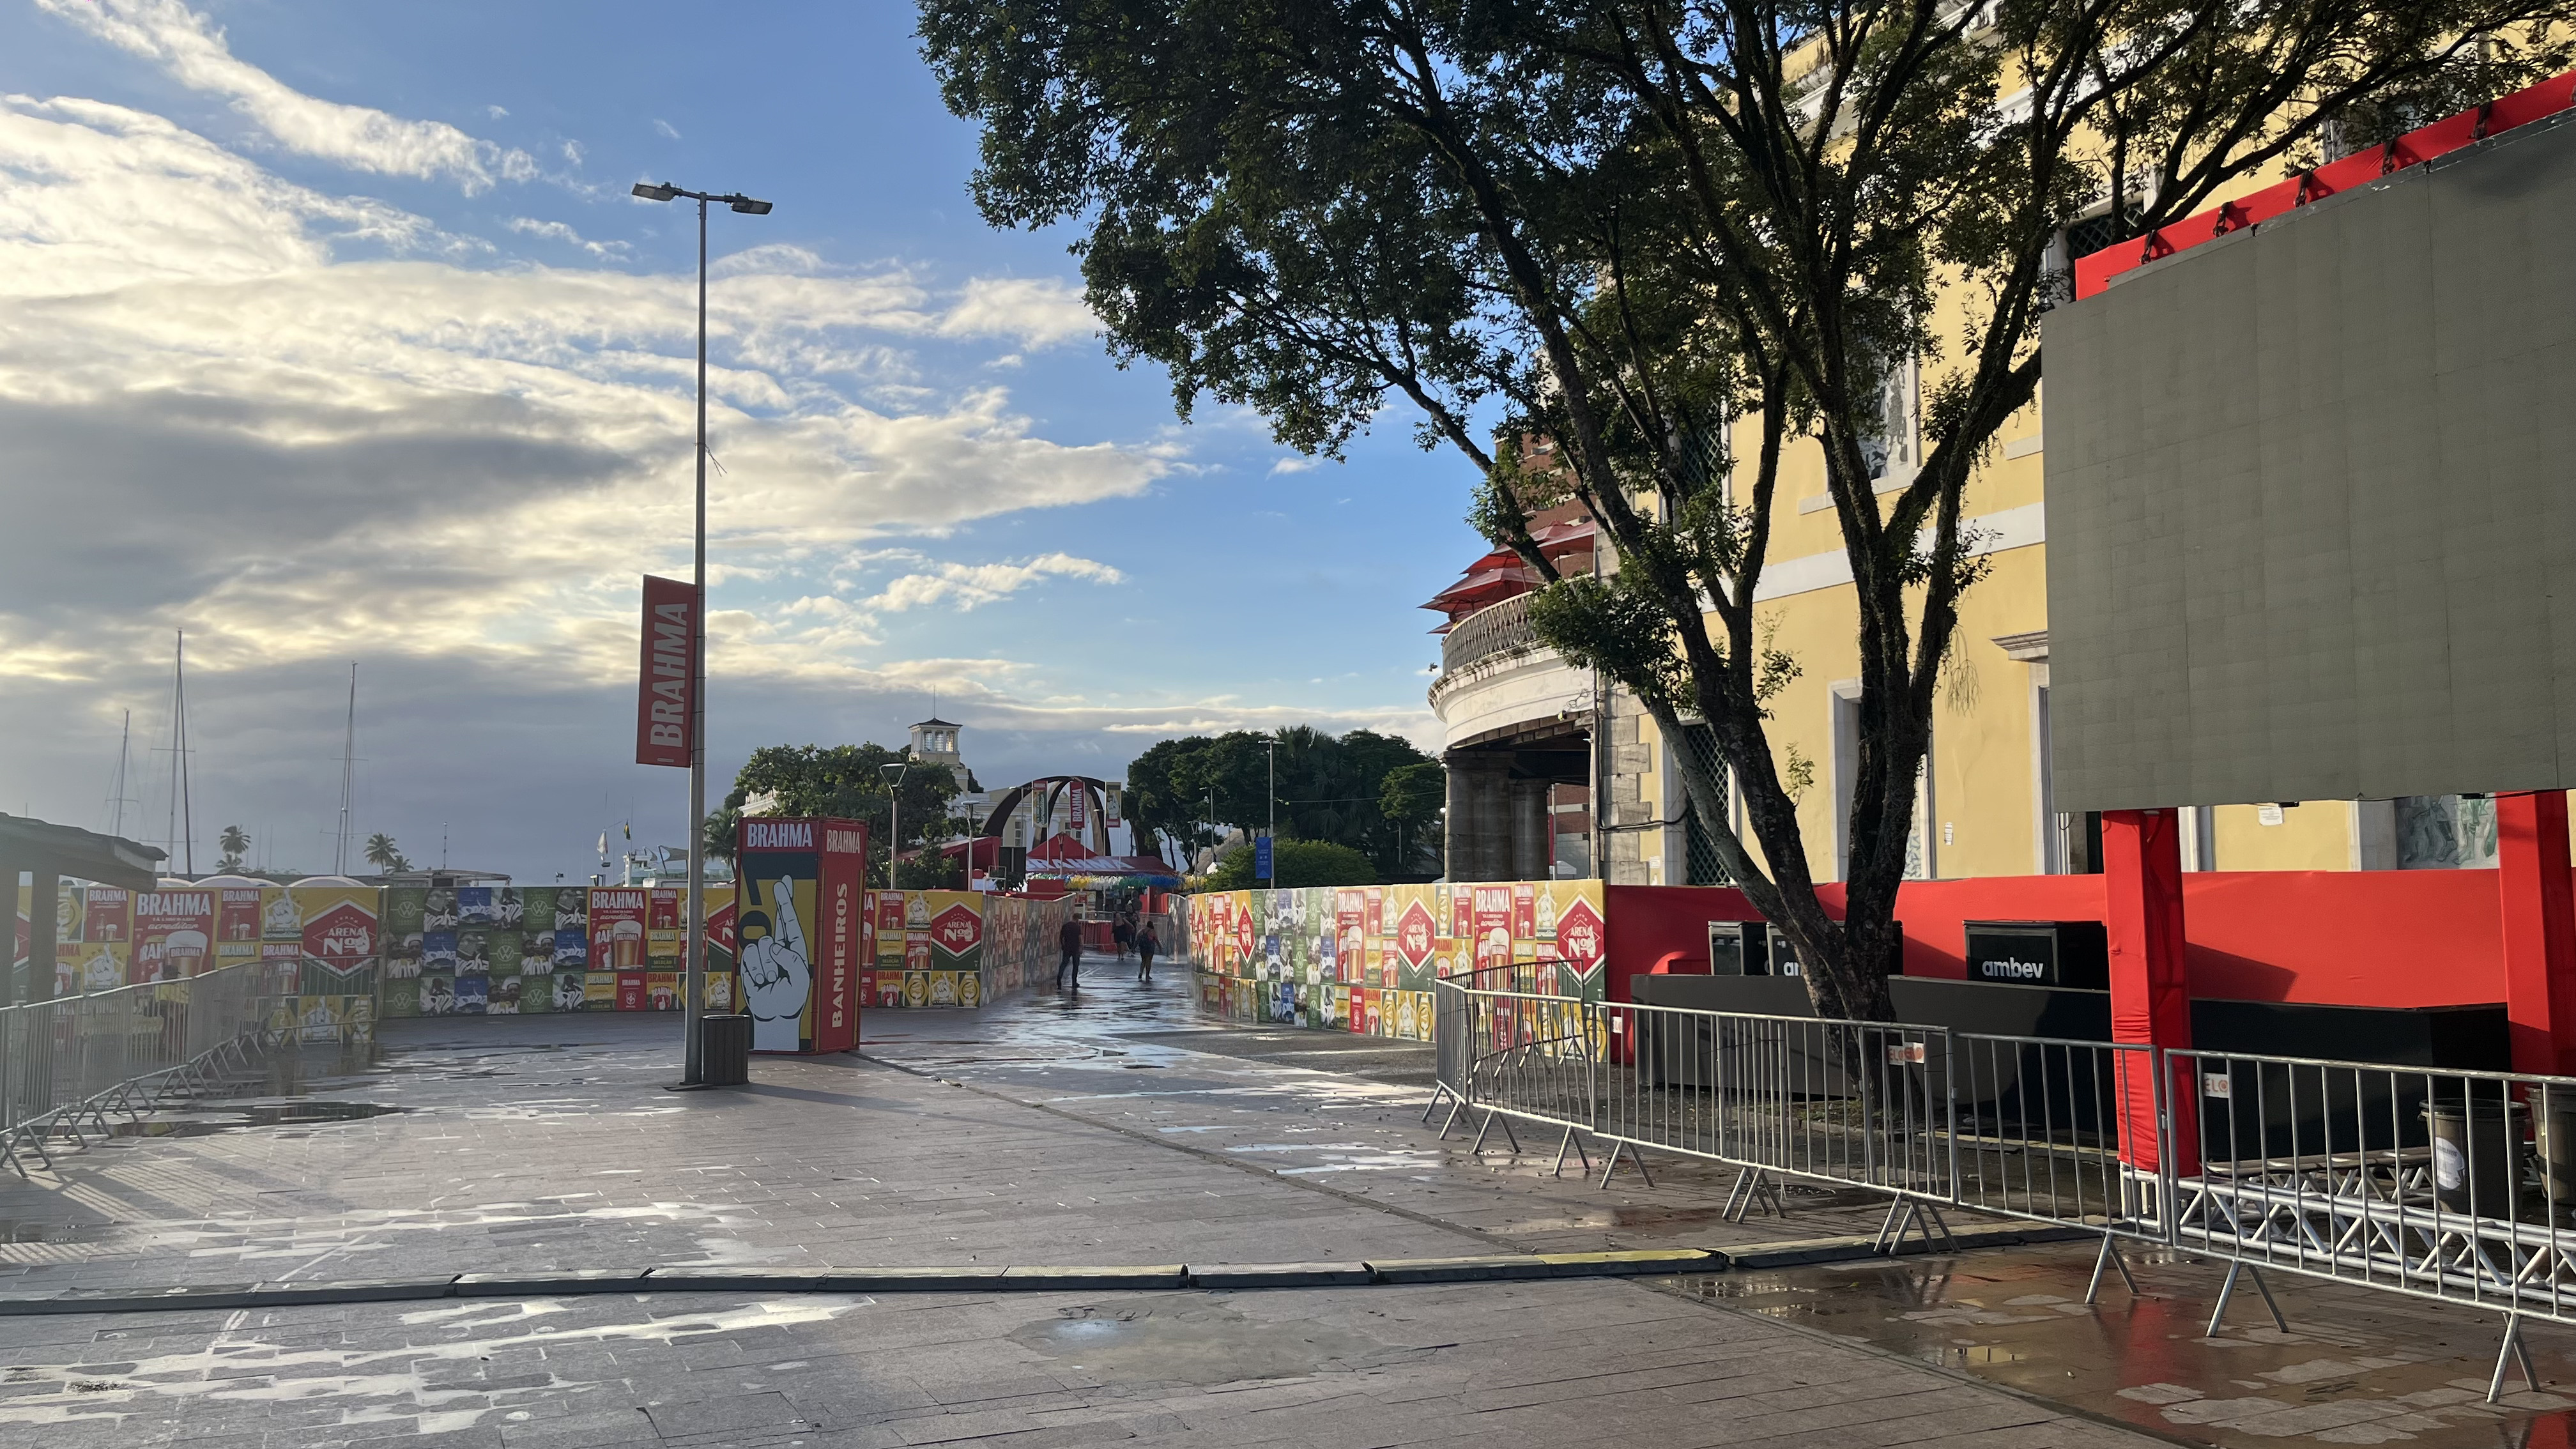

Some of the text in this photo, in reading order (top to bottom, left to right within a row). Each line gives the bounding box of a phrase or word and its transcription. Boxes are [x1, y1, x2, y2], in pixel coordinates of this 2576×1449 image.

[650, 603, 688, 747] BRAHMA
[1072, 788, 1082, 822] BRAHMA
[747, 824, 813, 848] BRAHMA
[827, 829, 861, 854] BRAHMA
[89, 889, 127, 901] BRAHMA
[223, 890, 259, 901] BRAHMA
[651, 889, 677, 899] BRAHMA
[880, 892, 903, 901] BRAHMA
[137, 893, 211, 916] BRAHMA
[592, 891, 644, 909] BRAHMA
[1338, 893, 1365, 912] BRAHMA
[1475, 889, 1510, 912] BRAHMA
[328, 928, 364, 937] ARENA
[650, 931, 675, 941] BRAHMA
[879, 931, 902, 941] BRAHMA
[1570, 926, 1590, 937] ARENA
[907, 933, 930, 942] BRAHMA
[171, 947, 201, 957] BRAHMA
[219, 945, 256, 956] BRAHMA
[263, 944, 299, 956] BRAHMA
[832, 883, 848, 1028] BANHEIROS
[1982, 957, 2044, 979] ambev
[587, 975, 614, 985] BRAHMA
[648, 973, 677, 983] BRAHMA
[877, 971, 903, 981] BRAHMA
